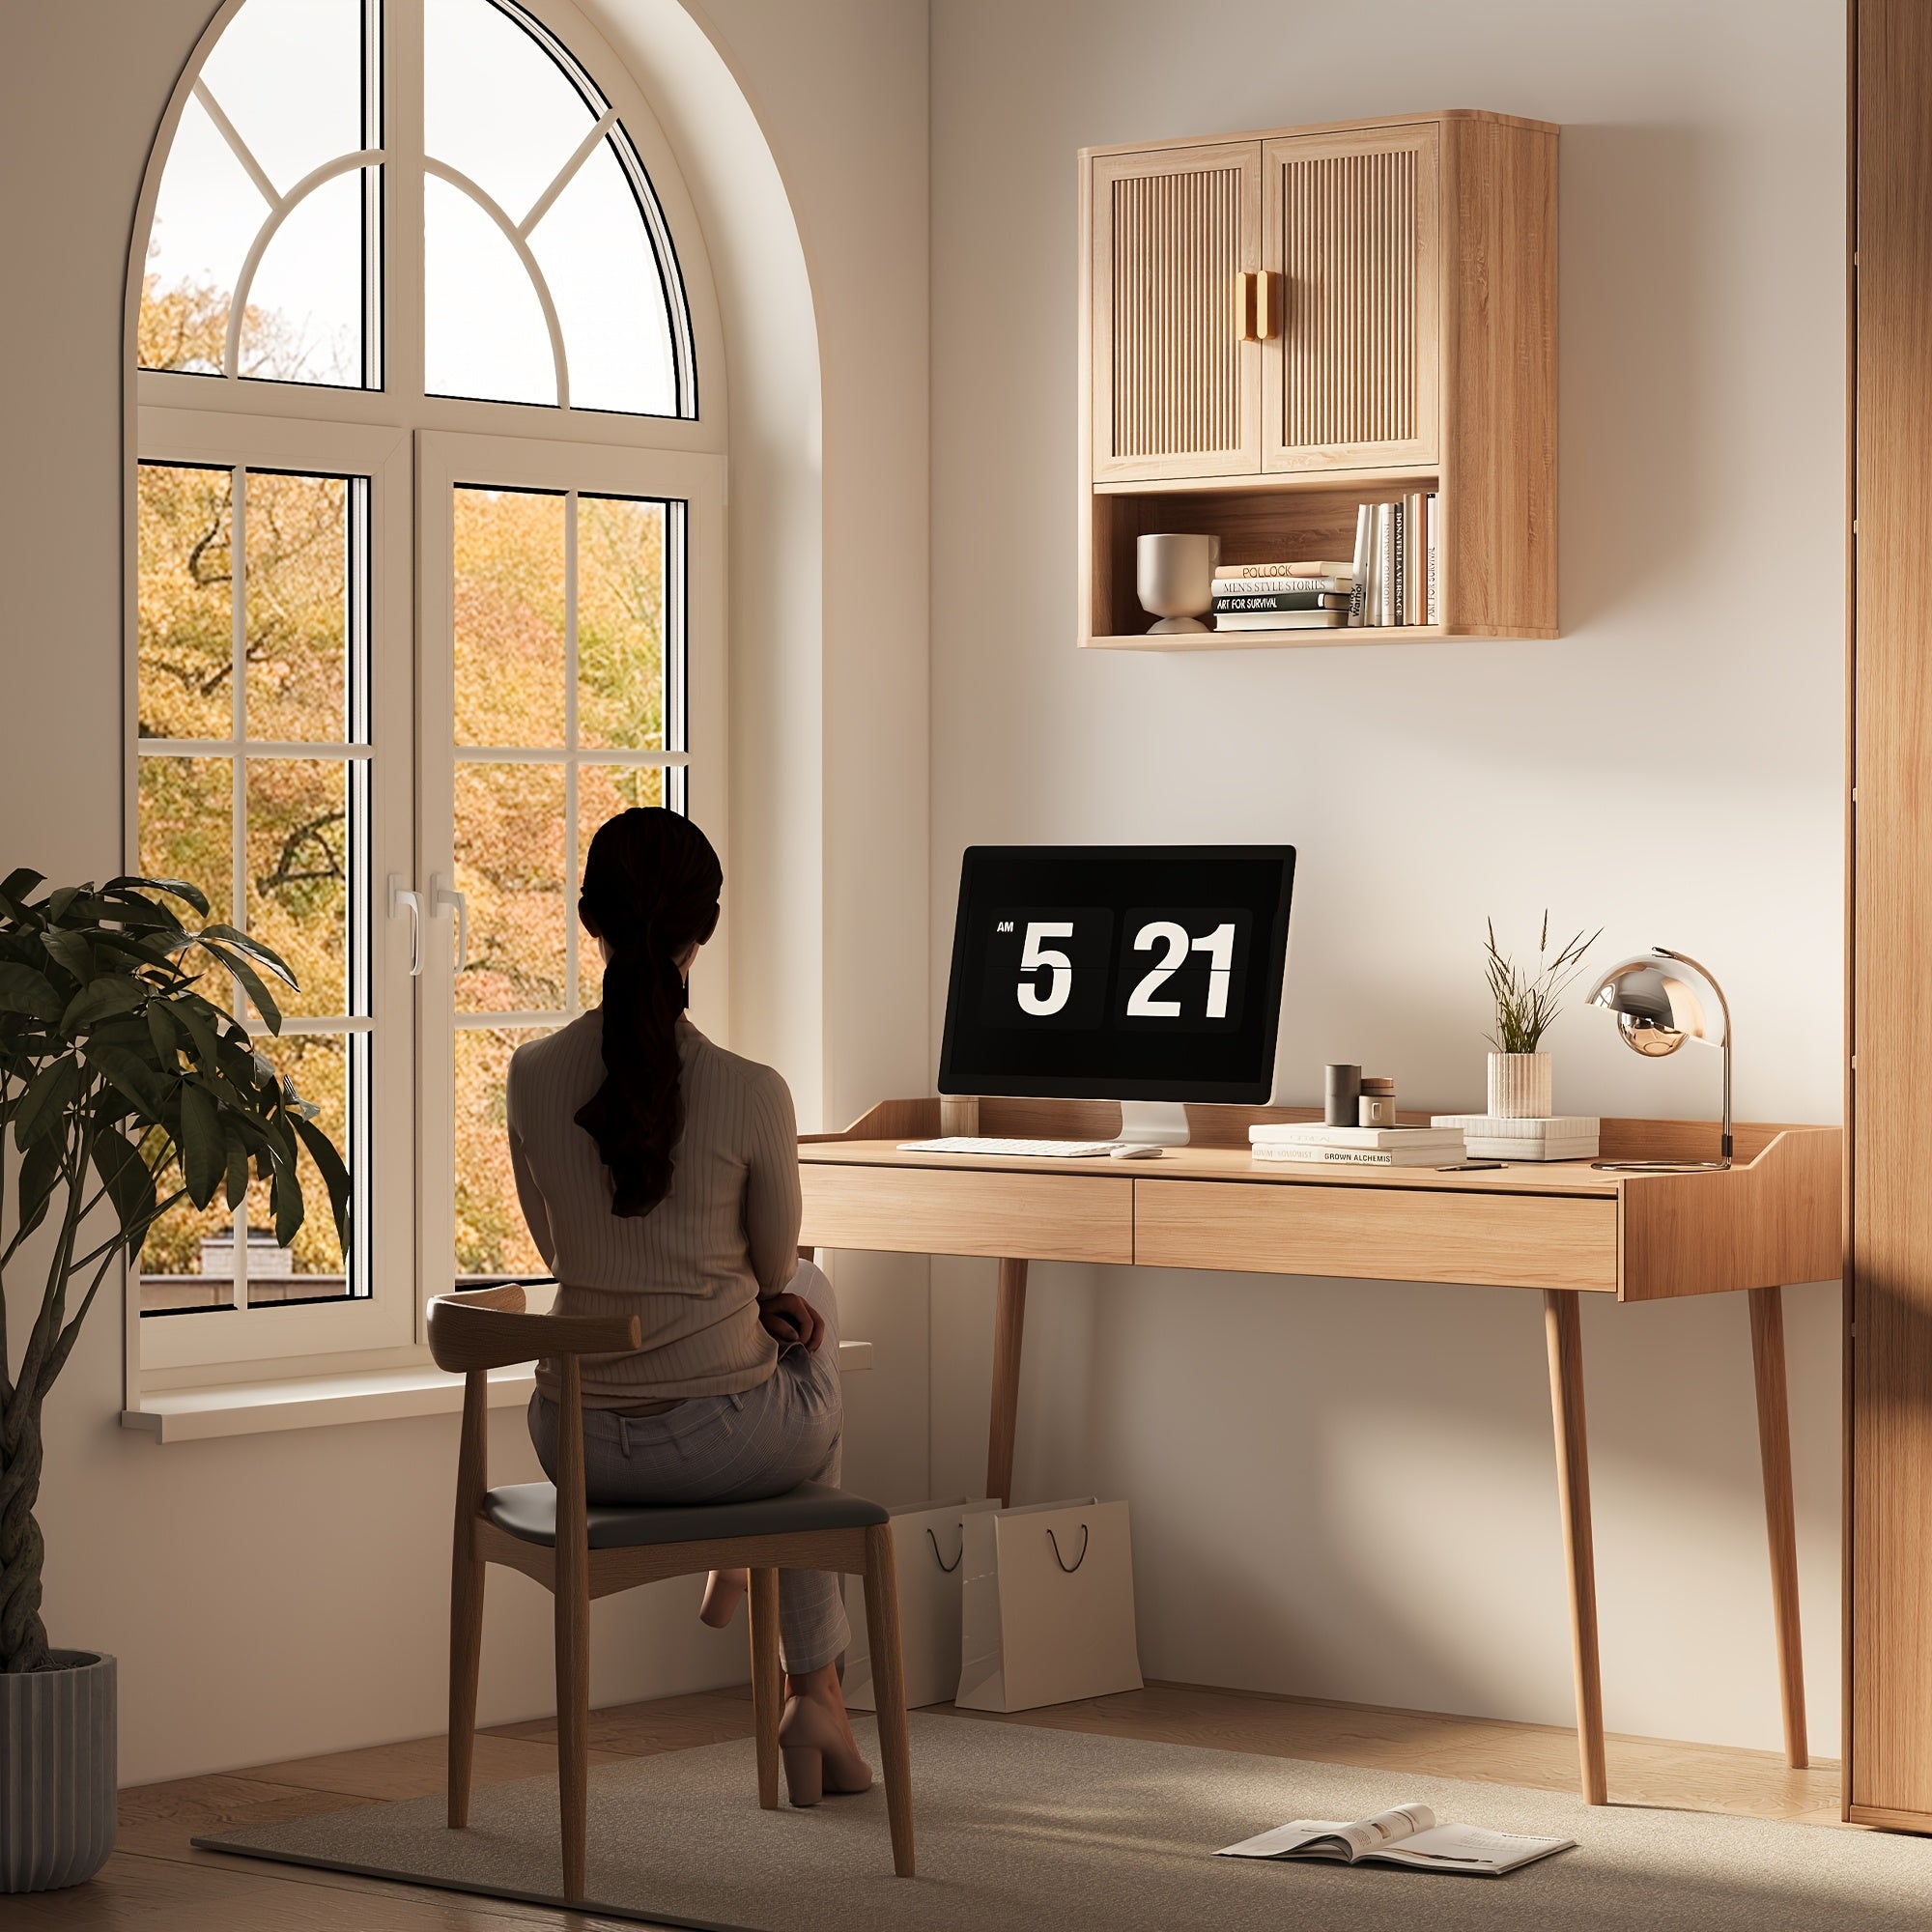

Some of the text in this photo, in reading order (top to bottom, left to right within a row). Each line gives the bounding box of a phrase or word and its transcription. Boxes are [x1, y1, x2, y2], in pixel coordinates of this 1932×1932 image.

[1242, 565, 1293, 578] POLLOCK
[1254, 582, 1284, 592] STYLE
[1285, 580, 1325, 591] STORIES
[1217, 597, 1277, 610] ART FOR SURVIVAL
[1351, 583, 1363, 617] Warhol
[997, 921, 1236, 1018] AM 5 21
[1324, 1152, 1351, 1161] GROWN
